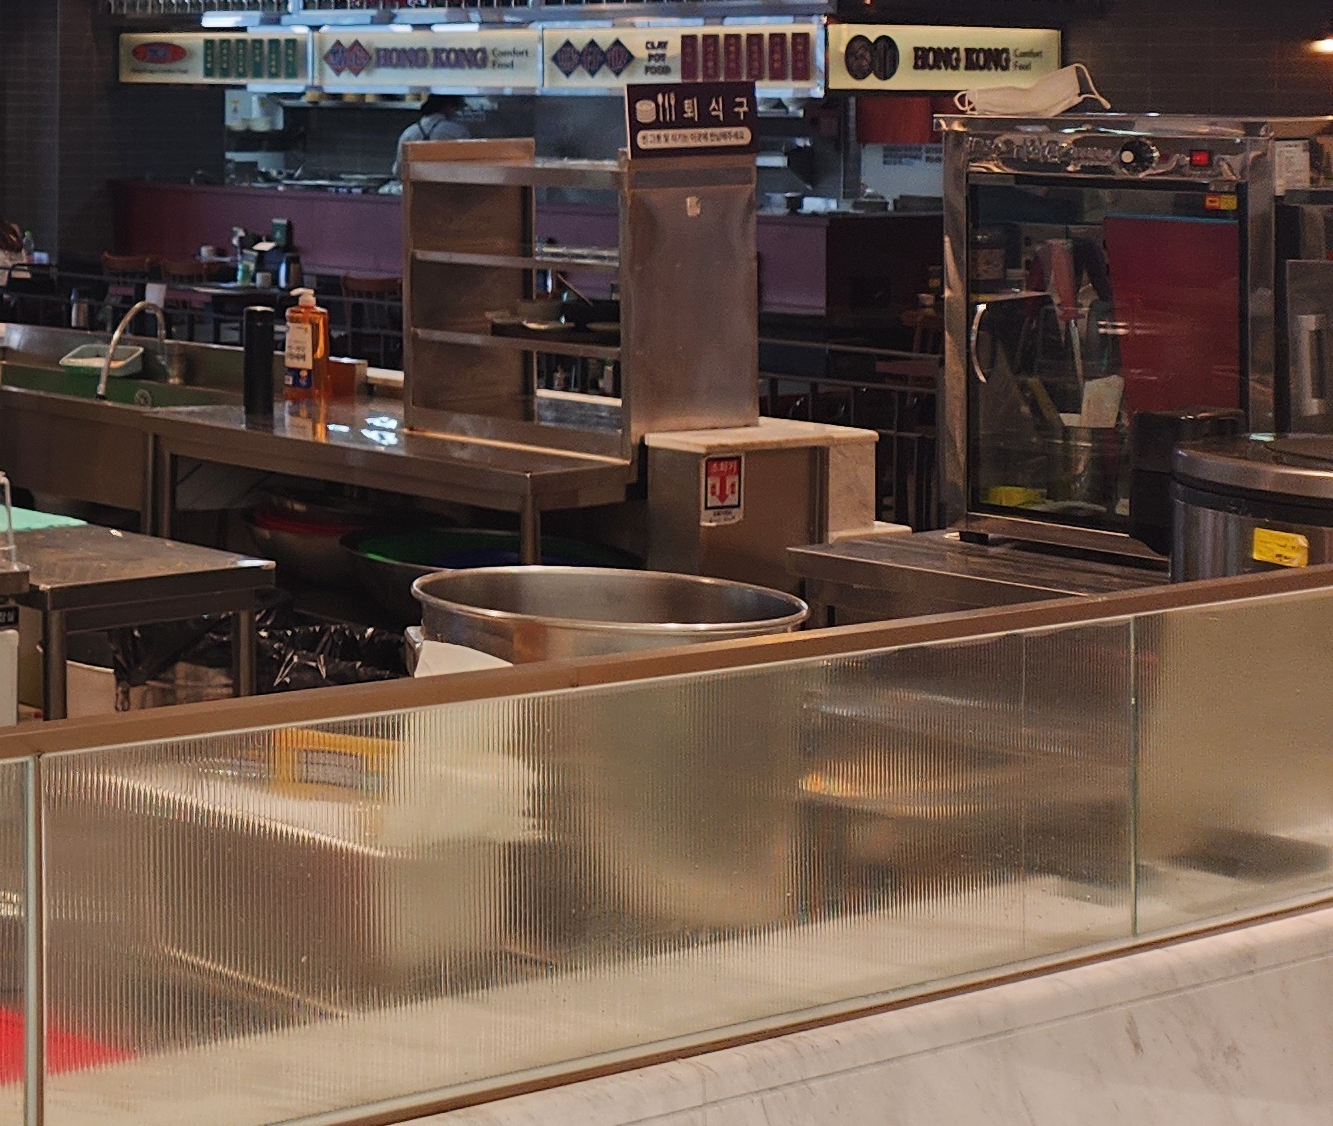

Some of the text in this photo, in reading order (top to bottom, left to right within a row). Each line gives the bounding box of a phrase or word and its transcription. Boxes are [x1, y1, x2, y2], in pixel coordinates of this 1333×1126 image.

[374, 47, 429, 69] HONG
[431, 47, 489, 69] KONG
[913, 46, 961, 71] HONG
[964, 47, 1012, 71] KONG
[683, 95, 749, 122] 퇴식구
